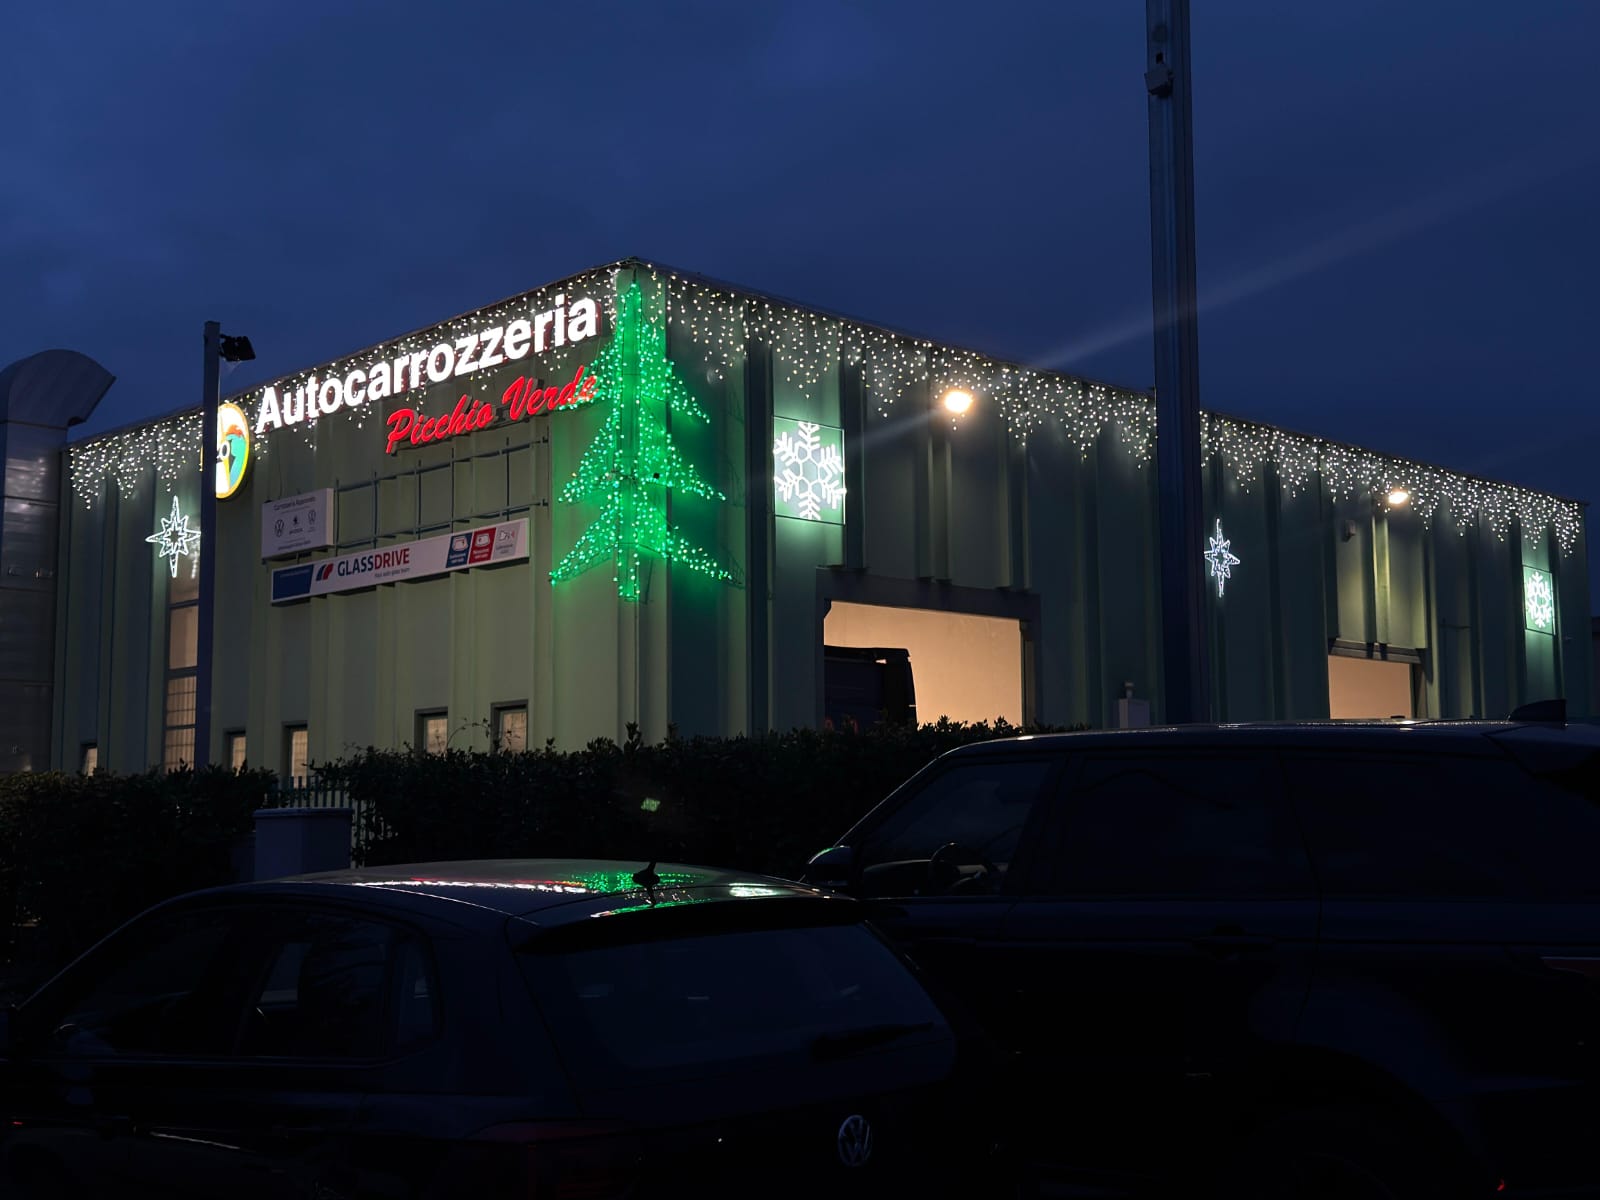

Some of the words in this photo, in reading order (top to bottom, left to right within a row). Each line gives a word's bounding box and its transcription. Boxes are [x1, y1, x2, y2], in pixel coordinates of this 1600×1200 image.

[255, 294, 599, 434] Autocarrozzeria
[385, 394, 494, 454] Picchio
[502, 365, 599, 421] Verde
[337, 547, 410, 577] GLASSDRIVE
